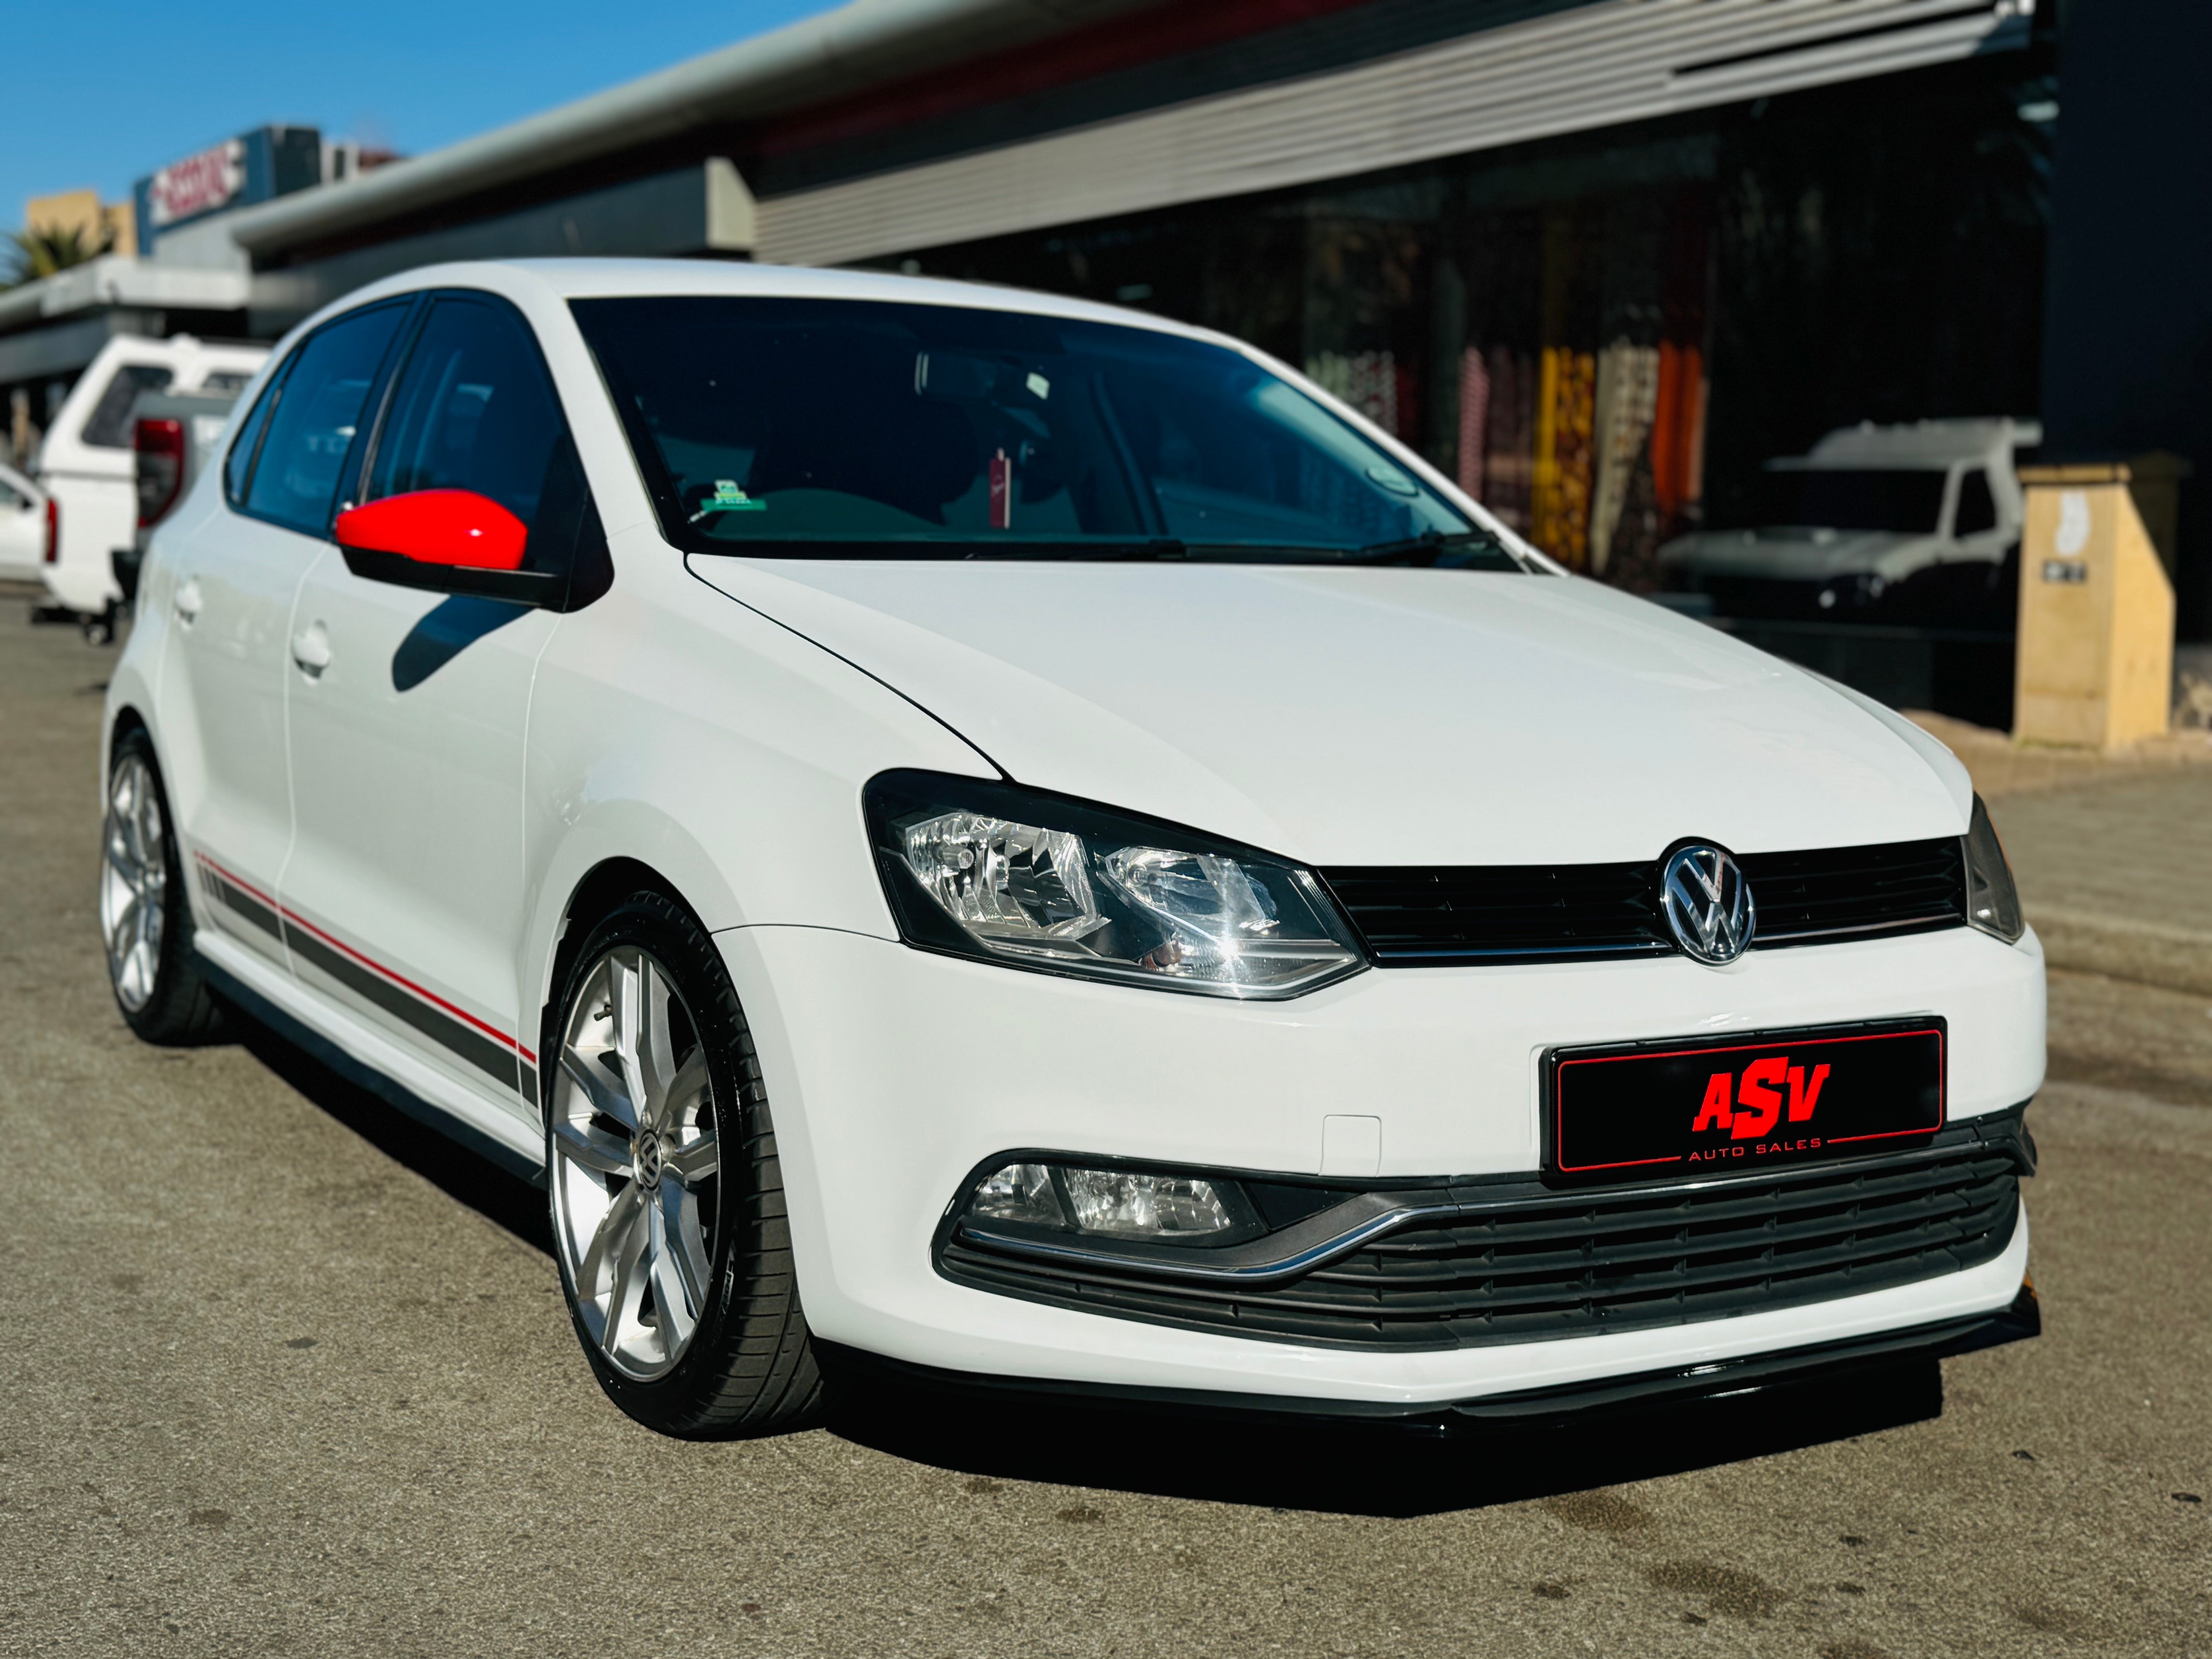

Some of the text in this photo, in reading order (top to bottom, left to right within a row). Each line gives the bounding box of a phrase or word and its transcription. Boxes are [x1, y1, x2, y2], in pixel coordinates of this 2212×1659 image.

[1692, 1056, 1831, 1140] ASV
[1690, 1138, 1821, 1161] AUTO SALES
